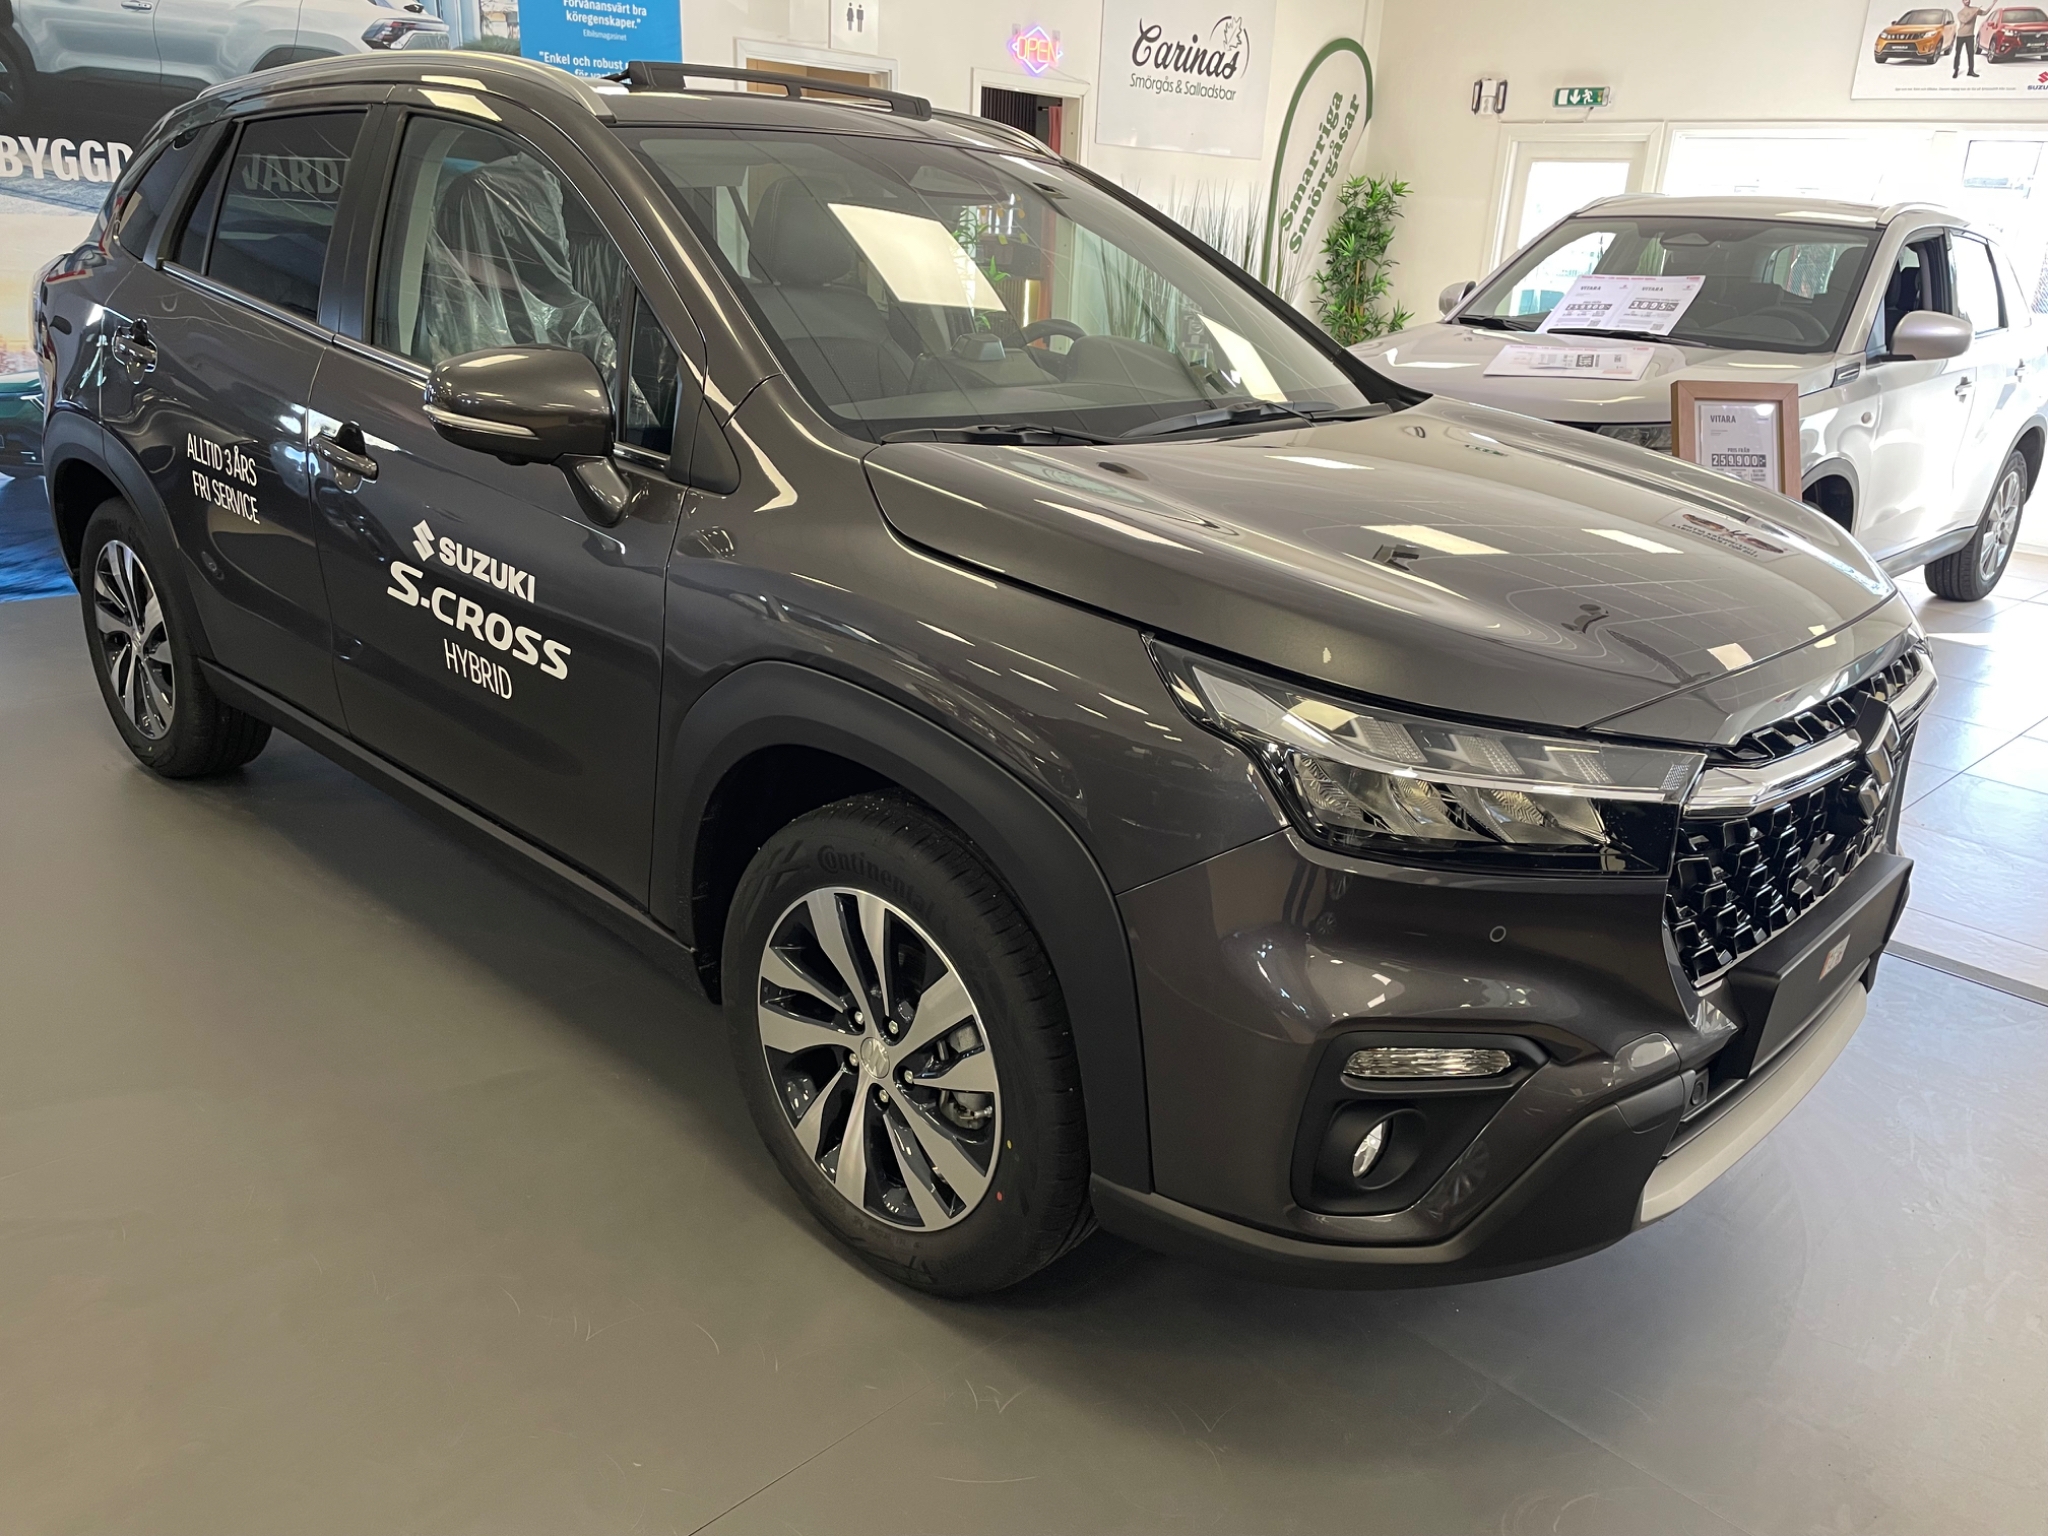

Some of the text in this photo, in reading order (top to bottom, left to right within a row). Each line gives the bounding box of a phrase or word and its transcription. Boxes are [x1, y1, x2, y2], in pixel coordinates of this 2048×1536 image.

[632, 4, 647, 16] bra
[539, 51, 570, 65] "Enkel
[573, 56, 590, 67] och
[593, 58, 623, 70] robust
[1017, 36, 1060, 65] OPEN
[1132, 18, 1239, 79] Carinas
[1130, 73, 1236, 100] Smörgås & Salladsbar
[1281, 92, 1343, 231] Smarriga
[1289, 94, 1359, 254] Smörgåsar
[1710, 415, 1736, 423] VITARA
[188, 433, 257, 486] ALLTID 3 ÅRS
[192, 470, 260, 524] FRI SERVICE
[439, 536, 536, 603] SUZUKI
[444, 638, 513, 699] HYBRID
